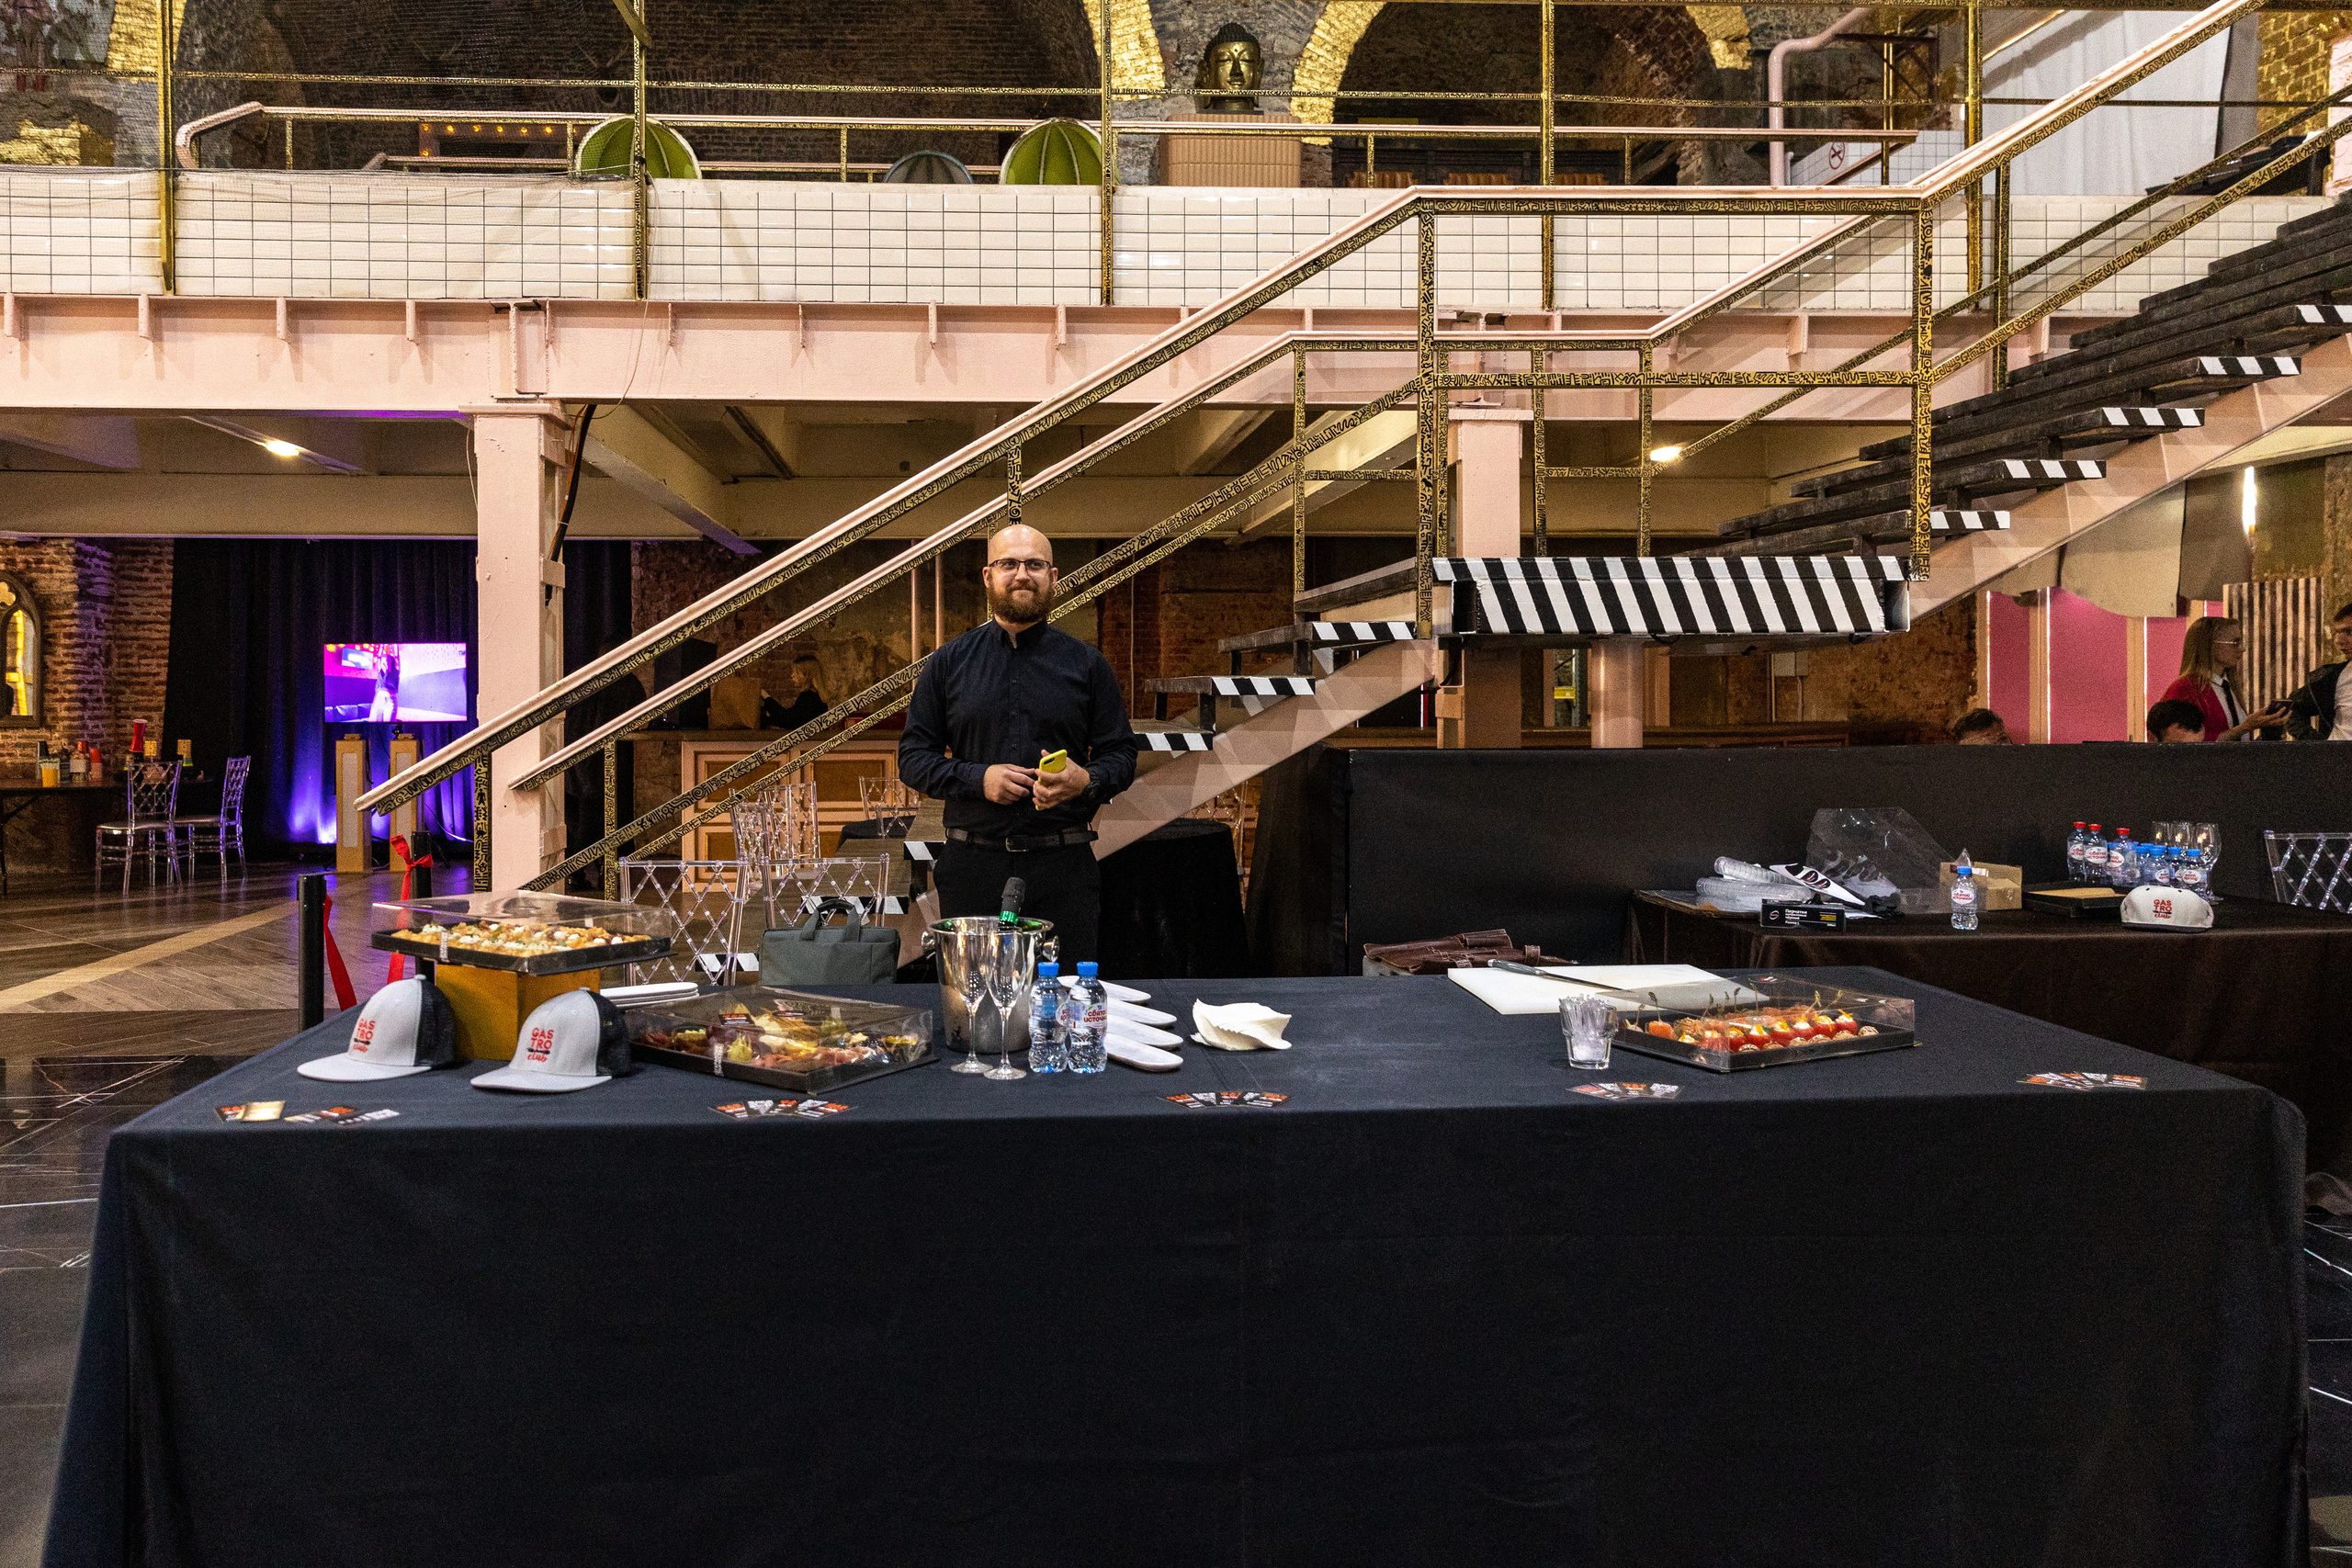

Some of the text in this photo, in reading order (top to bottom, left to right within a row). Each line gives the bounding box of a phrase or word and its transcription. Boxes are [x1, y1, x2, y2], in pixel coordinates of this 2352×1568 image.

[2154, 898, 2172, 907] GAS
[2154, 911, 2171, 919] club
[359, 1018, 376, 1031] GAS
[357, 1028, 374, 1041] TRO
[532, 1027, 554, 1040] GAS
[530, 1037, 553, 1050] TRO
[526, 1050, 548, 1063] club
